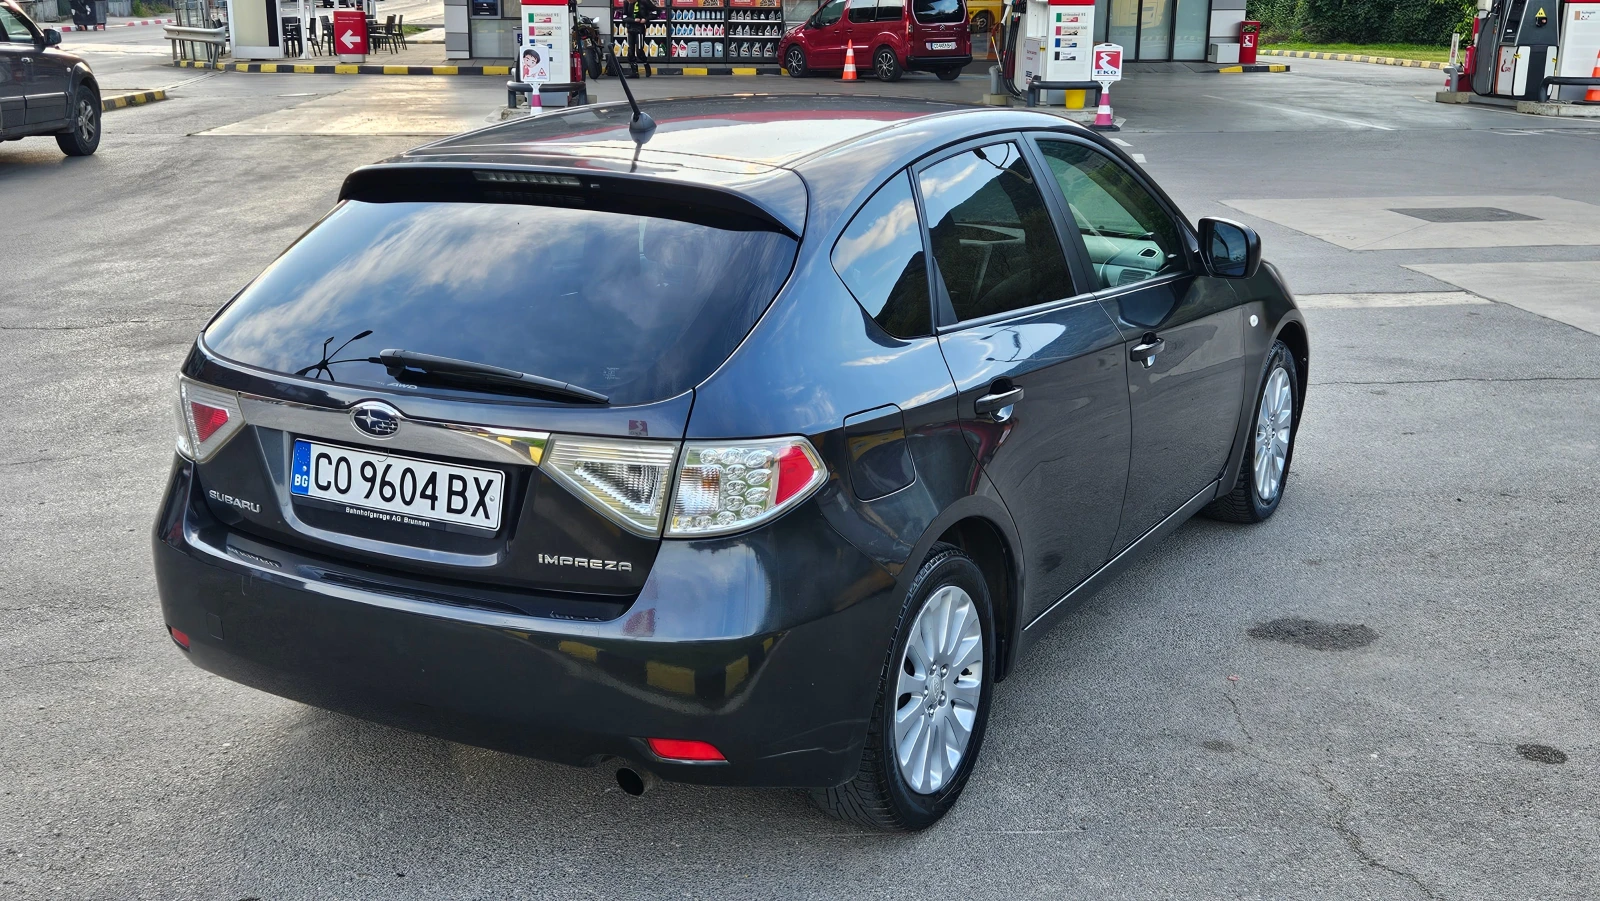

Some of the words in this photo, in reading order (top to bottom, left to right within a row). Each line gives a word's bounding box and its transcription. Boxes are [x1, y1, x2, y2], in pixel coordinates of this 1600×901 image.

[294, 473, 309, 487] BG
[314, 452, 352, 495] CO
[360, 460, 439, 511] 9604
[446, 473, 495, 520] BX
[208, 489, 260, 513] SUBARU
[345, 506, 391, 521] Bahnhofgarage
[403, 516, 430, 527] Brunnen
[538, 553, 632, 572] IMPREZA
